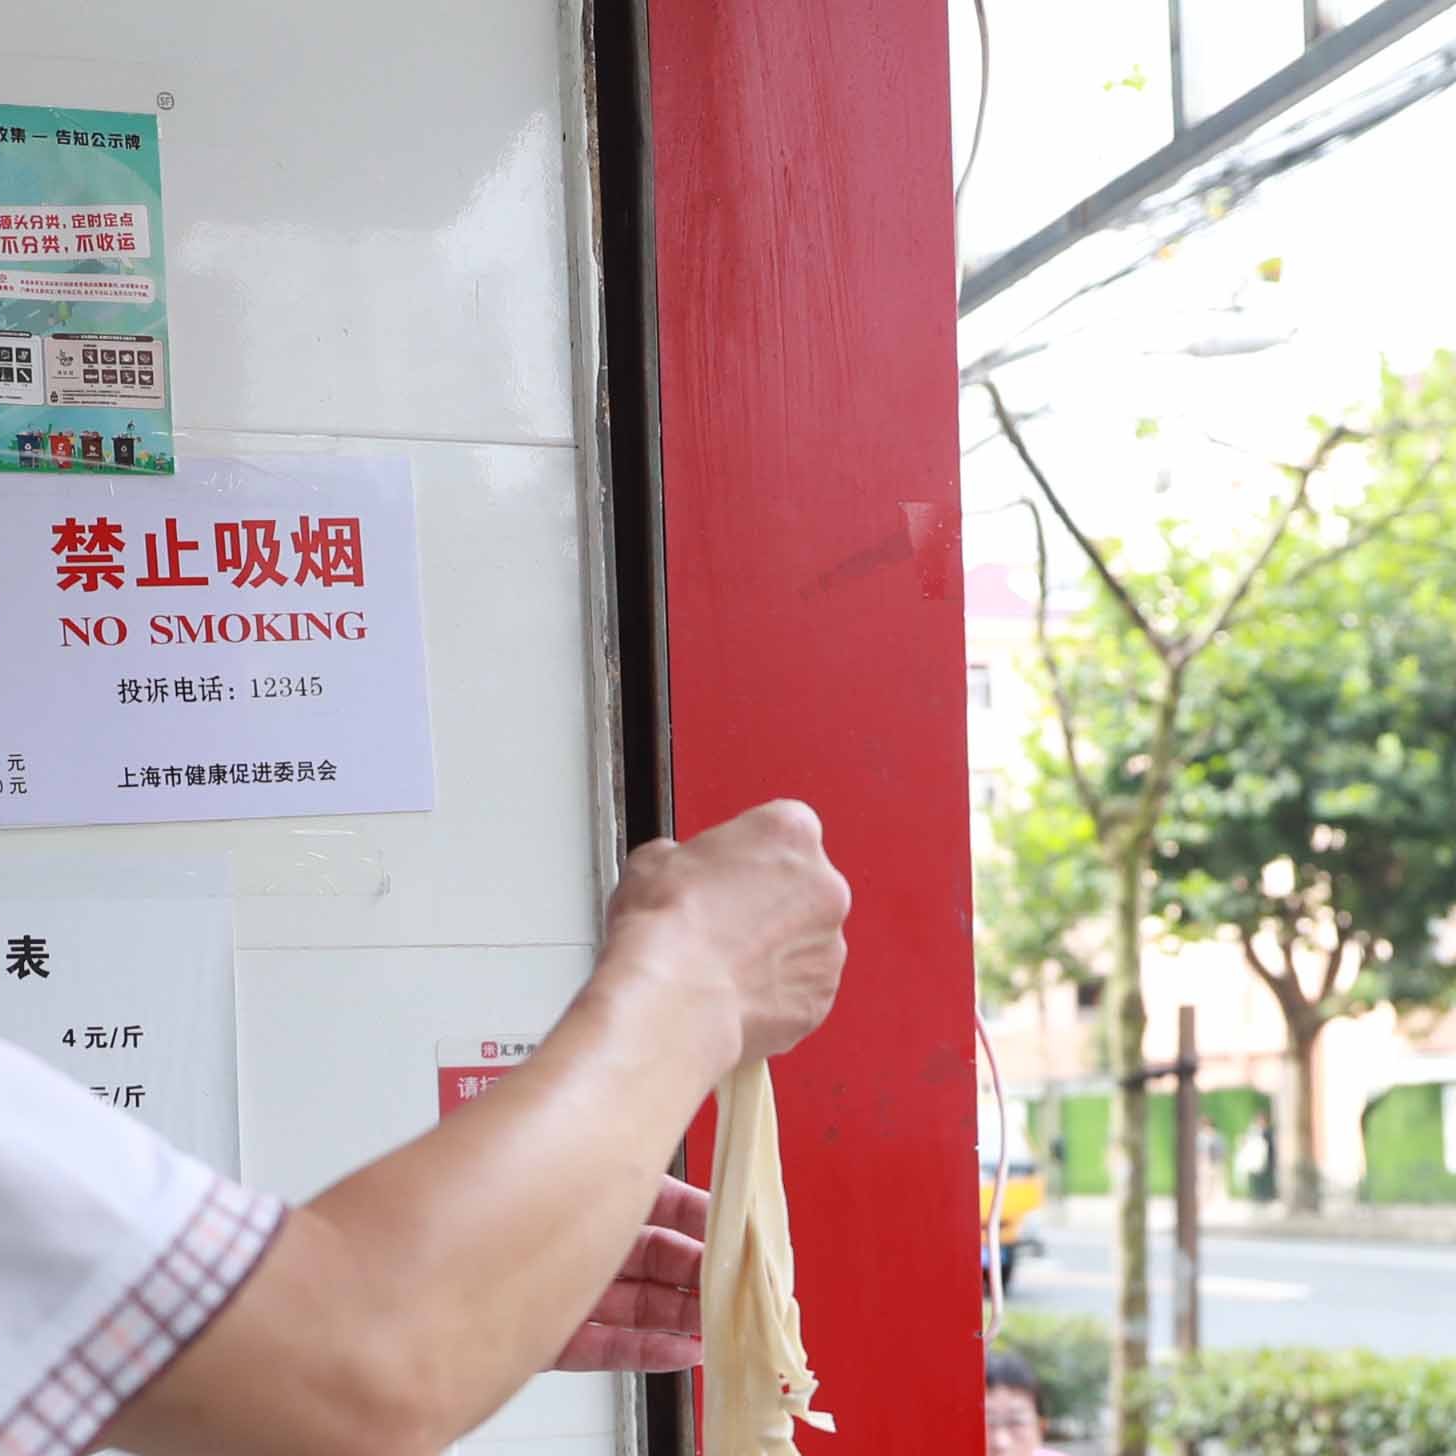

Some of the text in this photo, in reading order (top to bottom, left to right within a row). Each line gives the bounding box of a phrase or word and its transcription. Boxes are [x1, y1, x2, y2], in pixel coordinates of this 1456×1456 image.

[55, 128, 142, 151] 告知公示牌
[0, 233, 136, 254] 不分类，不收运
[51, 515, 366, 593] 禁止吸烟
[60, 611, 368, 646] NO SMOKING
[7, 753, 25, 773] 元
[117, 759, 338, 789] 上海市健康促进委员会
[9, 776, 28, 795] 元
